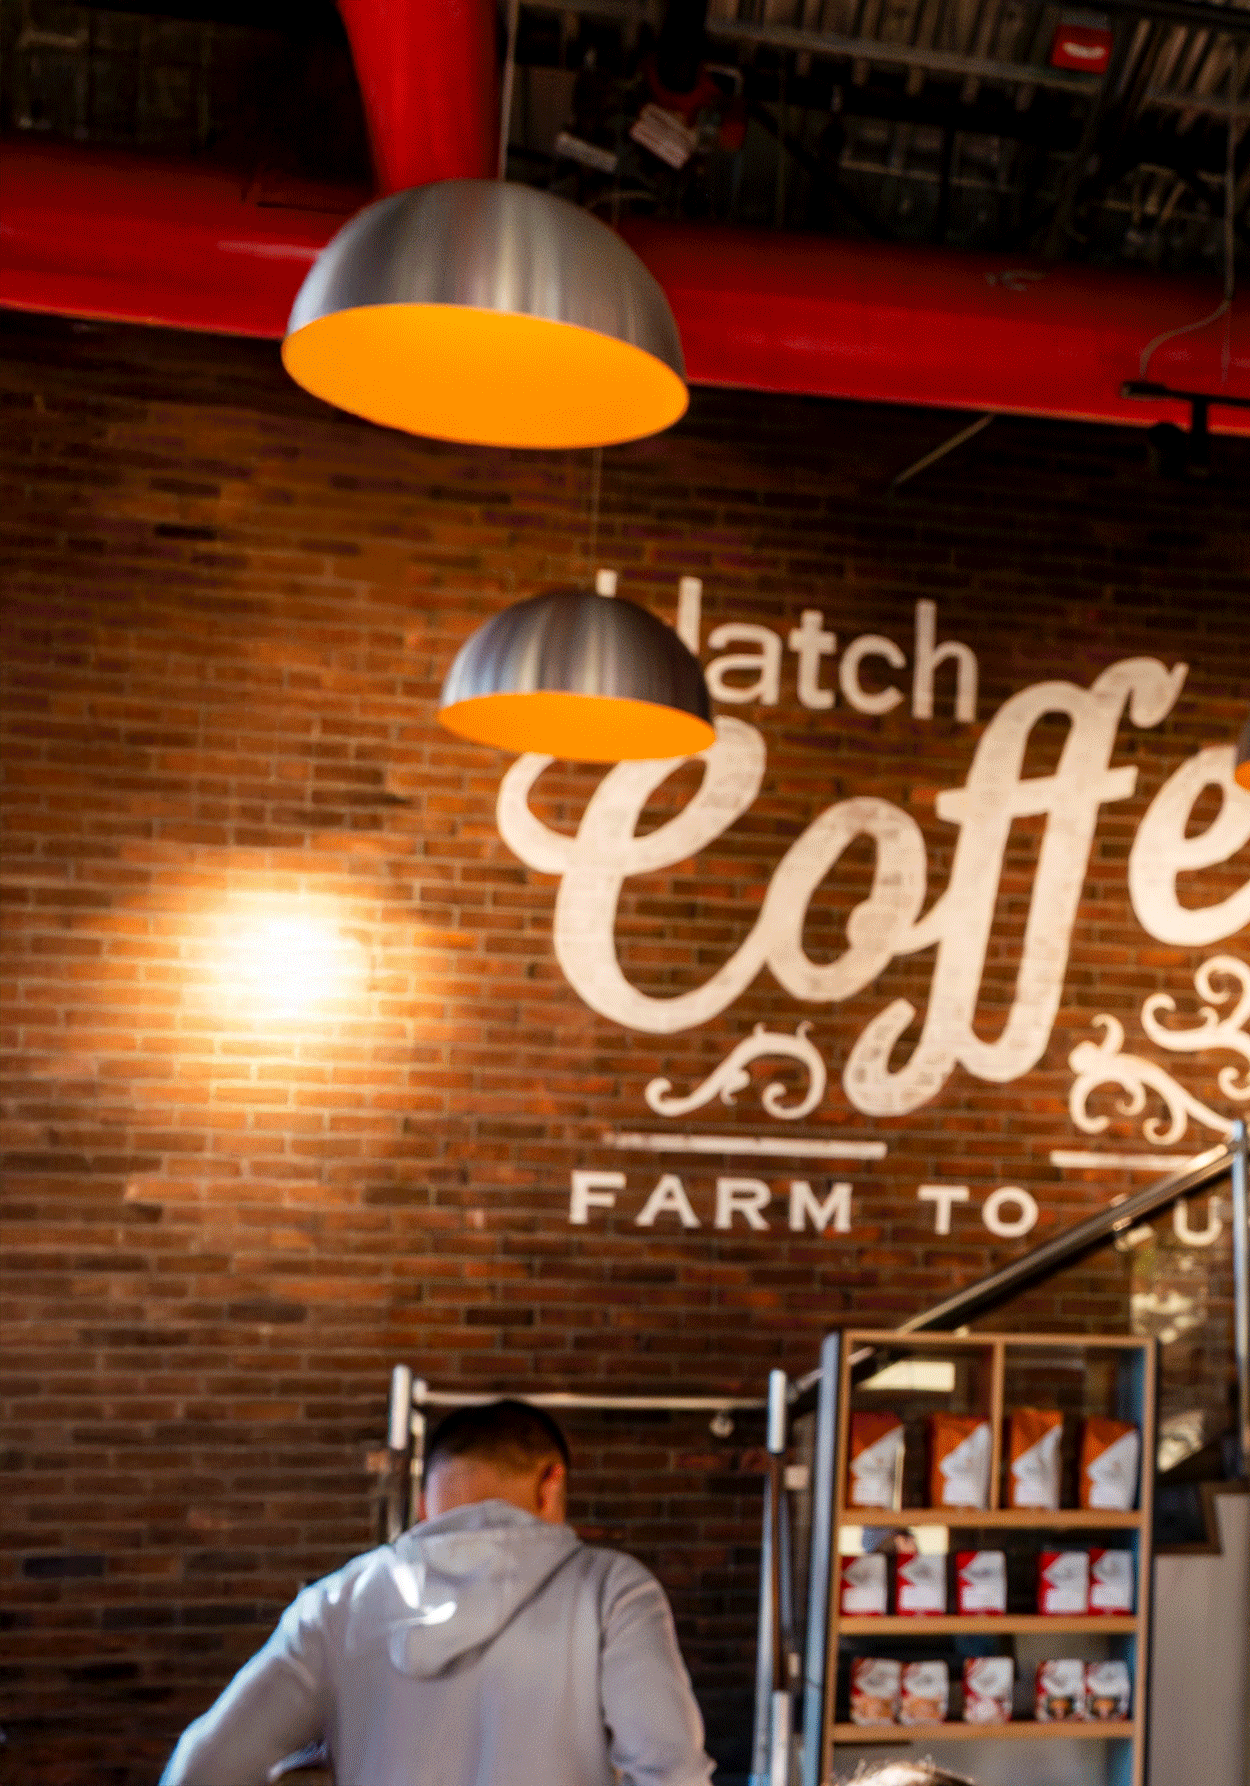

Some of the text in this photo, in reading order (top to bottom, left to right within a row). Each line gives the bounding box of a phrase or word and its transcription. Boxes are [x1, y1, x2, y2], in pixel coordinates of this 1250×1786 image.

[596, 569, 979, 721] latch
[568, 1170, 1039, 1238] FARM TO
